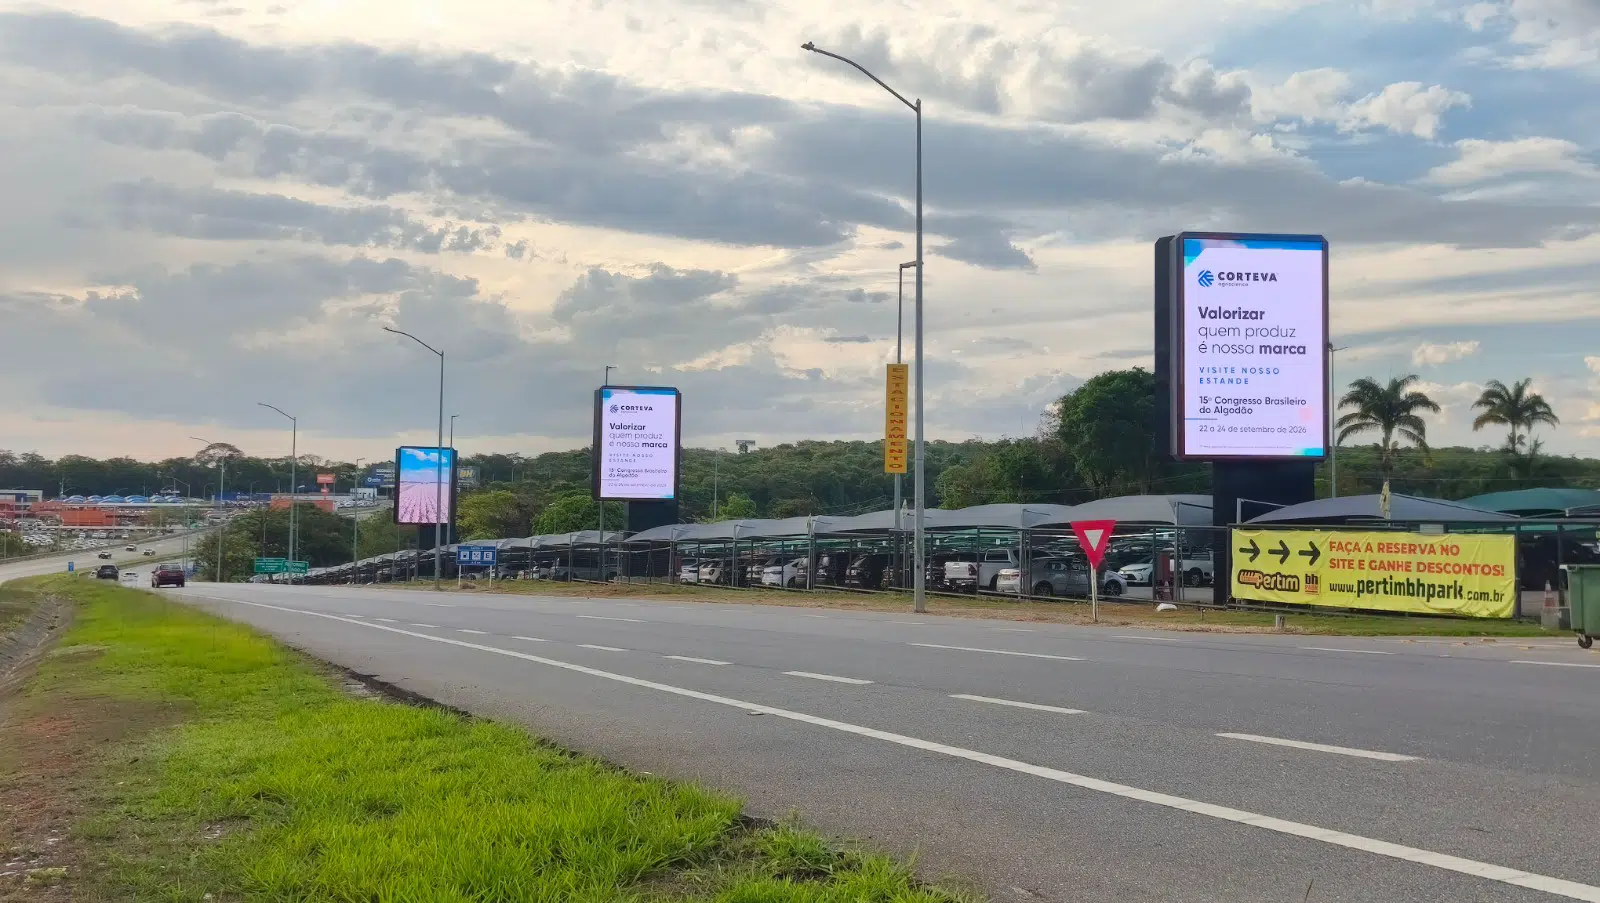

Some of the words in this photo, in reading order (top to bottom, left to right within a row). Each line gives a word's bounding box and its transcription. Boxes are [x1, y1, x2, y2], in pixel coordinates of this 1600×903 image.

[1218, 272, 1278, 282] CORTEVA
[1198, 306, 1266, 320] Valorizar
[1198, 326, 1240, 340] quem
[1245, 325, 1296, 340] produz
[1198, 340, 1208, 354] é
[1212, 344, 1254, 354] nossa
[1260, 344, 1306, 354] marca
[1214, 396, 1262, 406] Congresso
[1265, 396, 1306, 406] Brasileiro
[888, 367, 905, 469] ESTACIONAMENTO
[1200, 406, 1211, 414] do
[1214, 406, 1253, 416] Algodão
[610, 422, 646, 430] Valorizar
[1329, 540, 1362, 555] FAÇA
[1364, 542, 1374, 553] A
[1377, 542, 1436, 555] RESERVA
[1440, 544, 1460, 556] NO
[1329, 558, 1354, 569] SITE
[1358, 560, 1366, 570] E
[1369, 560, 1412, 572] GANHE
[1416, 562, 1505, 576] DESCONTOS!
[1253, 570, 1299, 592] Pertim
[1304, 574, 1318, 584] bh
[1329, 575, 1505, 602] www.pertimbhpark.com.br
